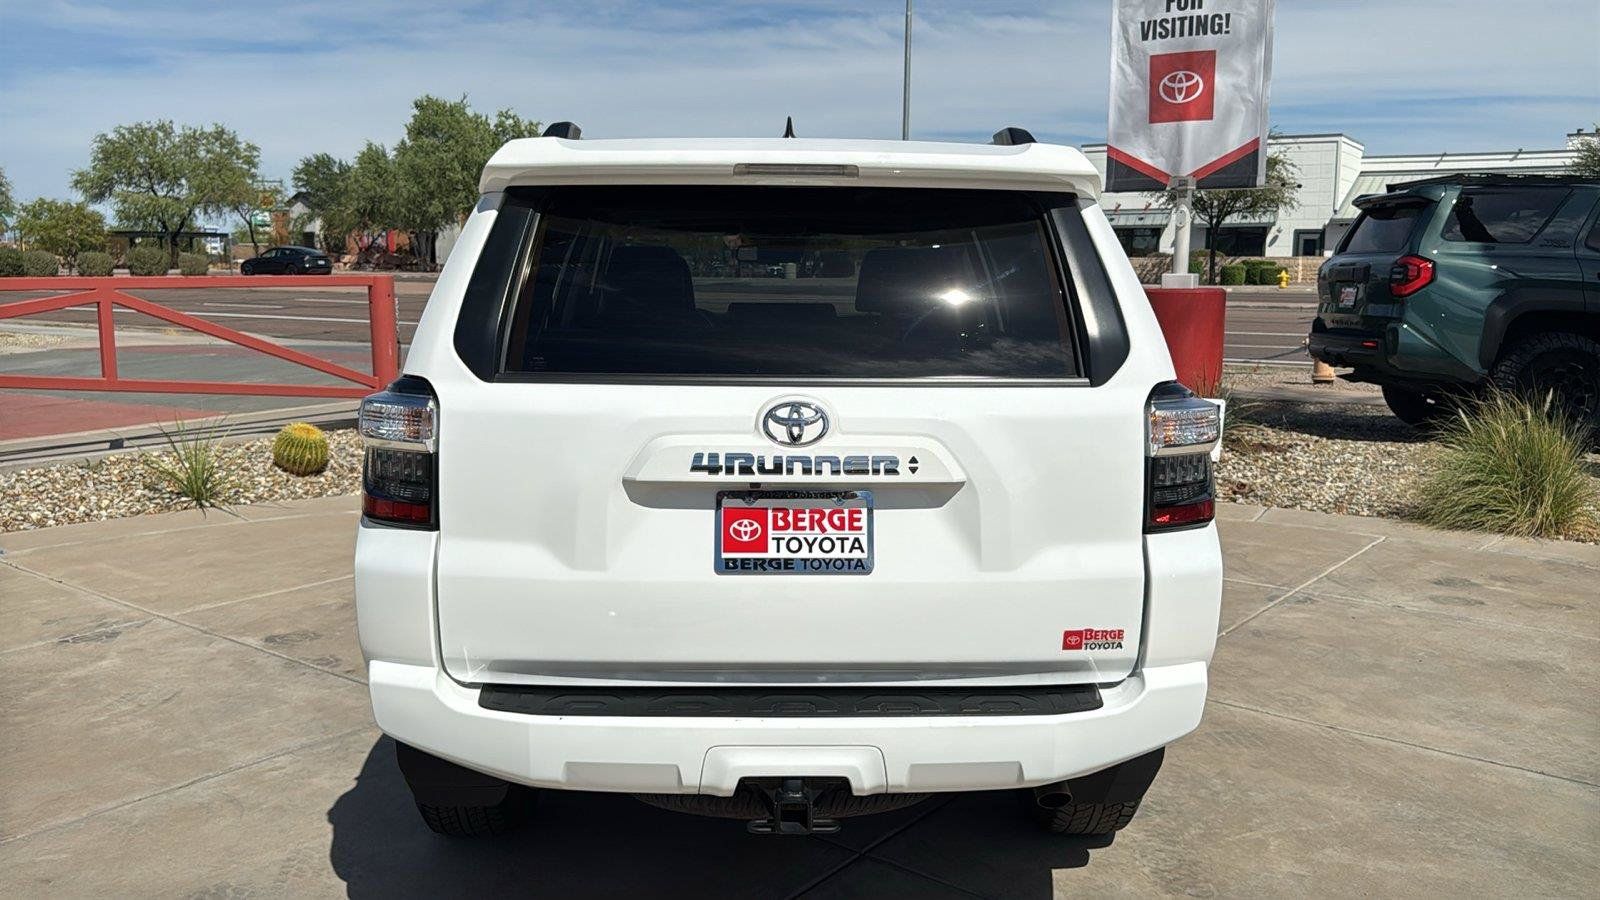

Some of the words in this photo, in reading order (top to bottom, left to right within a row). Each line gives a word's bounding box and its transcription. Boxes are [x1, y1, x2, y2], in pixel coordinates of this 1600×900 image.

[1140, 13, 1231, 41] VISITING!
[772, 507, 863, 534] BERGE
[772, 537, 865, 554] TOYOTA
[724, 558, 795, 571] BERGE
[801, 558, 866, 571] TOYOTA
[1084, 628, 1125, 640] BERGE
[1084, 641, 1123, 650] TOYOTA
